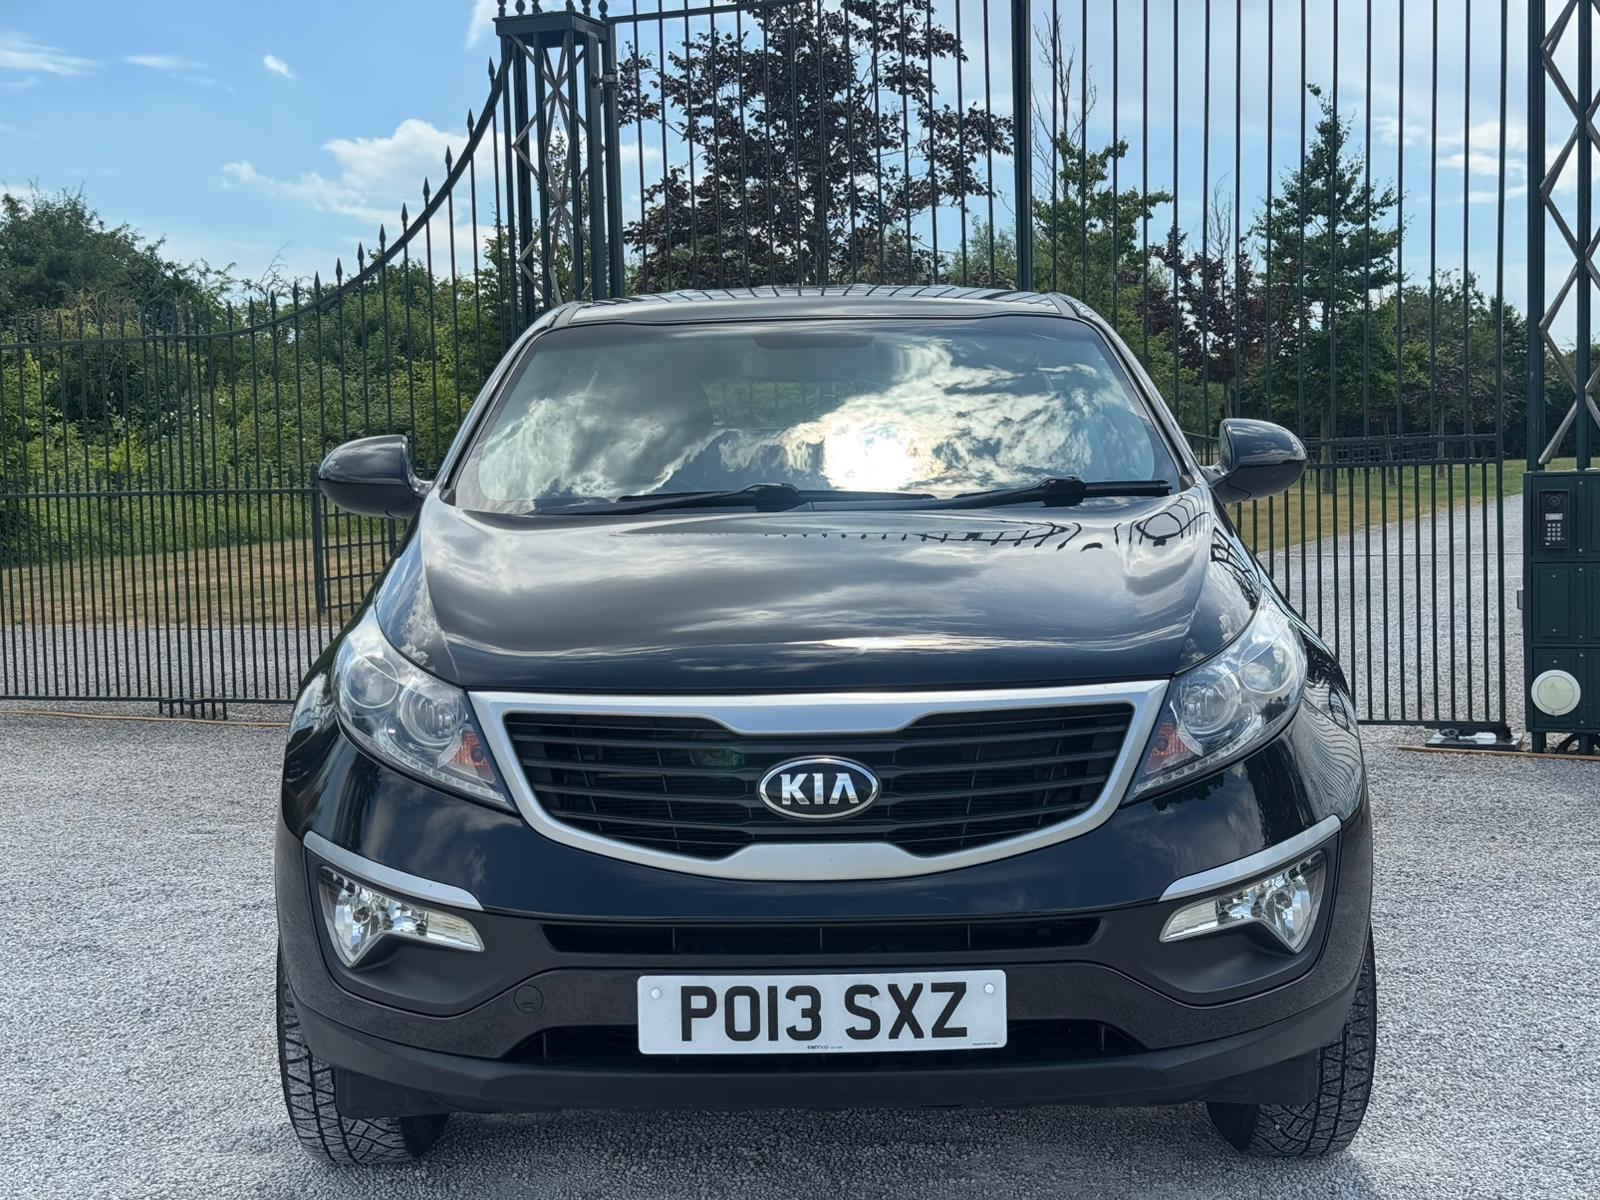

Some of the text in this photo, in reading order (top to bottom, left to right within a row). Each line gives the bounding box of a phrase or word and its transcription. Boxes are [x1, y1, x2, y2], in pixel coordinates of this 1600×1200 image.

[780, 772, 860, 806] KIA
[680, 981, 968, 1042] PO13 SXZ
